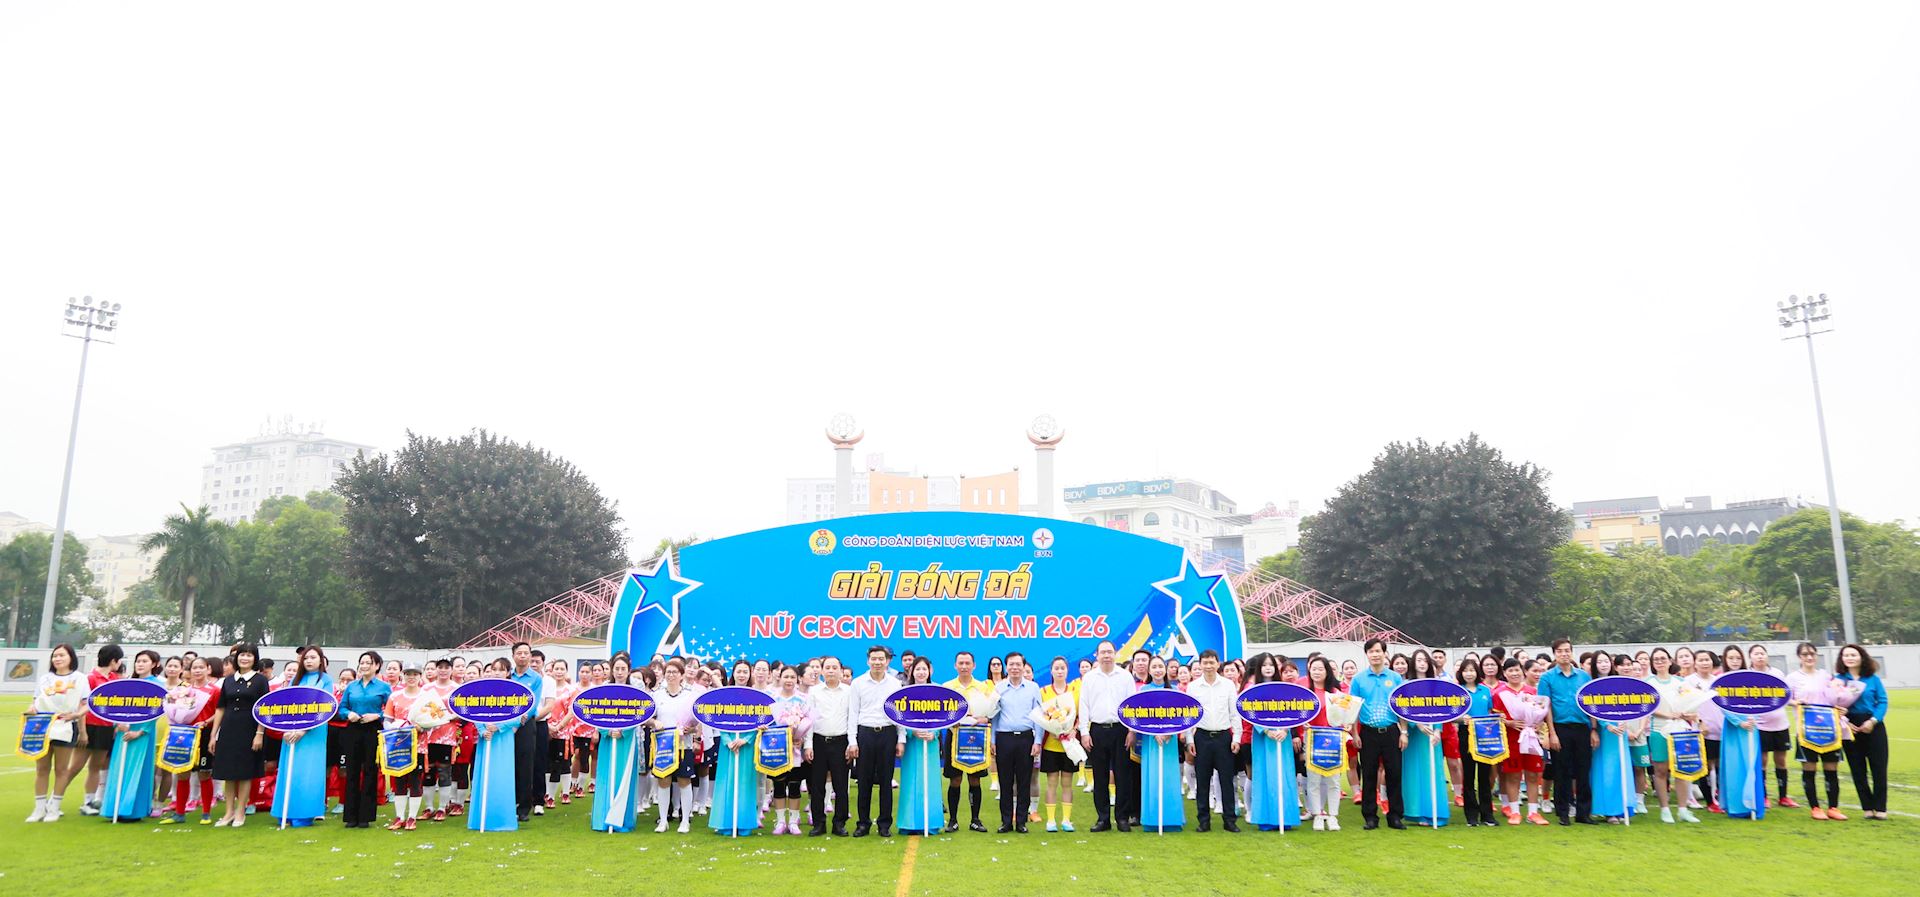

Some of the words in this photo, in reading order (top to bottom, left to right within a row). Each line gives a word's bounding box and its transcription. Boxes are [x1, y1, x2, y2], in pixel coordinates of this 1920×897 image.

[1064, 491, 1082, 499] BIDV
[1097, 486, 1117, 496] BIDV
[1142, 485, 1161, 494] BIDV
[843, 534, 877, 547] CÔNG
[880, 533, 912, 547] ĐOÀN
[915, 534, 941, 549] ĐIỆN
[944, 535, 966, 549] LỰC
[968, 534, 994, 548] VIỆT
[996, 536, 1023, 546] NAM
[829, 562, 891, 599] GIẢI
[894, 563, 981, 599] BÓNG
[984, 563, 1031, 599] ĐÁ
[750, 611, 794, 638] NỮ
[799, 615, 898, 638] CBCNV
[903, 615, 961, 638] EVN
[969, 610, 1037, 638] NĂM
[1043, 615, 1109, 638] 2026
[93, 693, 109, 706] TỔNG
[108, 695, 125, 706] CÔNG
[125, 697, 132, 706] TY
[132, 695, 148, 706] PHÁT
[454, 693, 467, 706] TỔNG
[467, 695, 480, 706] CÔNG
[480, 697, 485, 706] TY
[486, 694, 497, 708] ĐIỆN
[497, 695, 506, 708] LỰC
[894, 696, 907, 712] TỔ
[908, 700, 941, 714] TRỌNG
[943, 698, 959, 711] TÀI
[1242, 698, 1253, 711] TỔNG
[1253, 699, 1264, 711] CÔNG
[1278, 700, 1286, 712] LỰC
[1395, 694, 1410, 706] TỔNG
[1410, 695, 1425, 706] CÔNG
[1425, 697, 1433, 706] TY
[1433, 695, 1446, 706] PHÁT
[259, 702, 270, 716] TỔNG
[270, 703, 282, 715] CÔNG
[288, 703, 298, 716] ĐIỆN
[298, 703, 307, 716] LỰC
[1122, 704, 1135, 718] TỔNG
[1135, 706, 1149, 718] CÔNG
[1149, 708, 1155, 718] TY
[1155, 706, 1167, 719] ĐIỆN
[1167, 707, 1176, 719] LỰC
[201, 757, 207, 766] 8
[340, 755, 346, 765] 5
